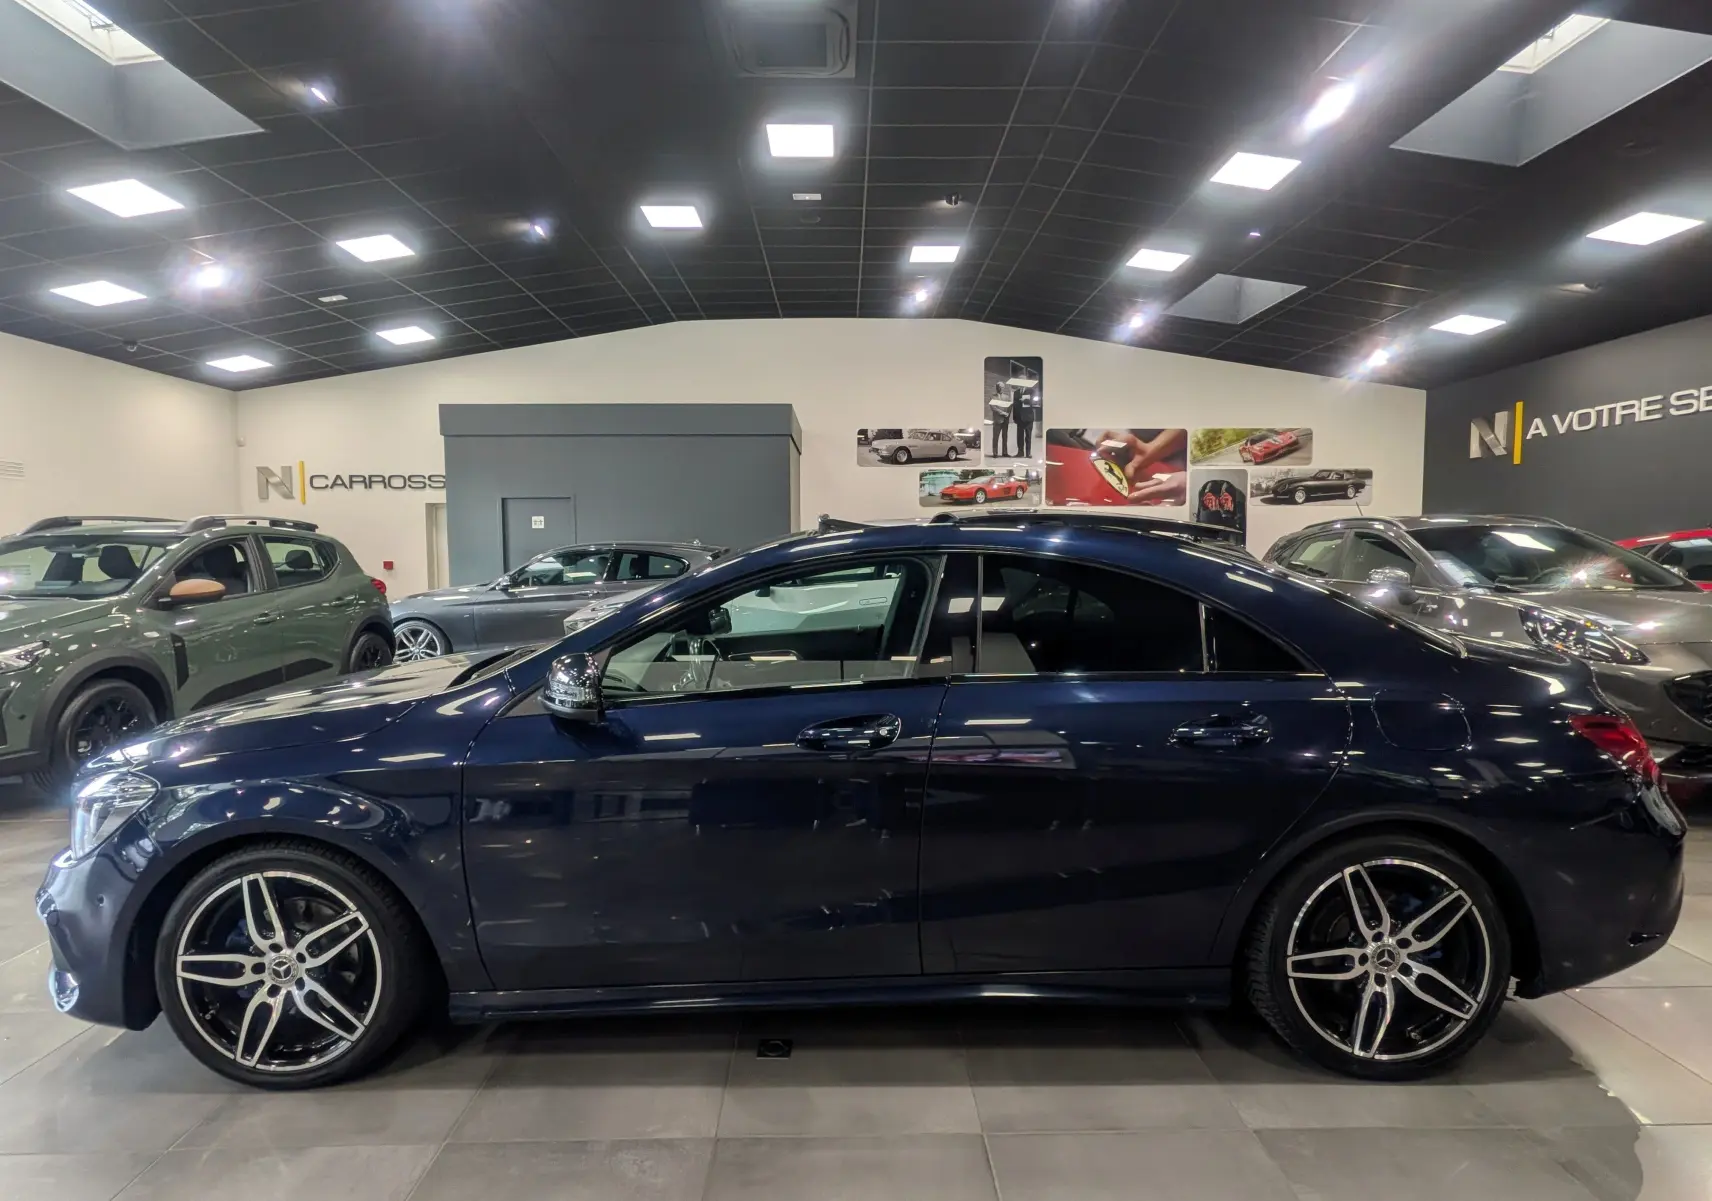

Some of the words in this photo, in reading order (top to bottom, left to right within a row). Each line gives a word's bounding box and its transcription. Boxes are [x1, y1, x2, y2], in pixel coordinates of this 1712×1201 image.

[1526, 417, 1548, 440] A
[1552, 395, 1665, 435] VOTRE
[1669, 385, 1712, 416] SE
[256, 466, 295, 500] N
[309, 474, 446, 489] CARROSS
